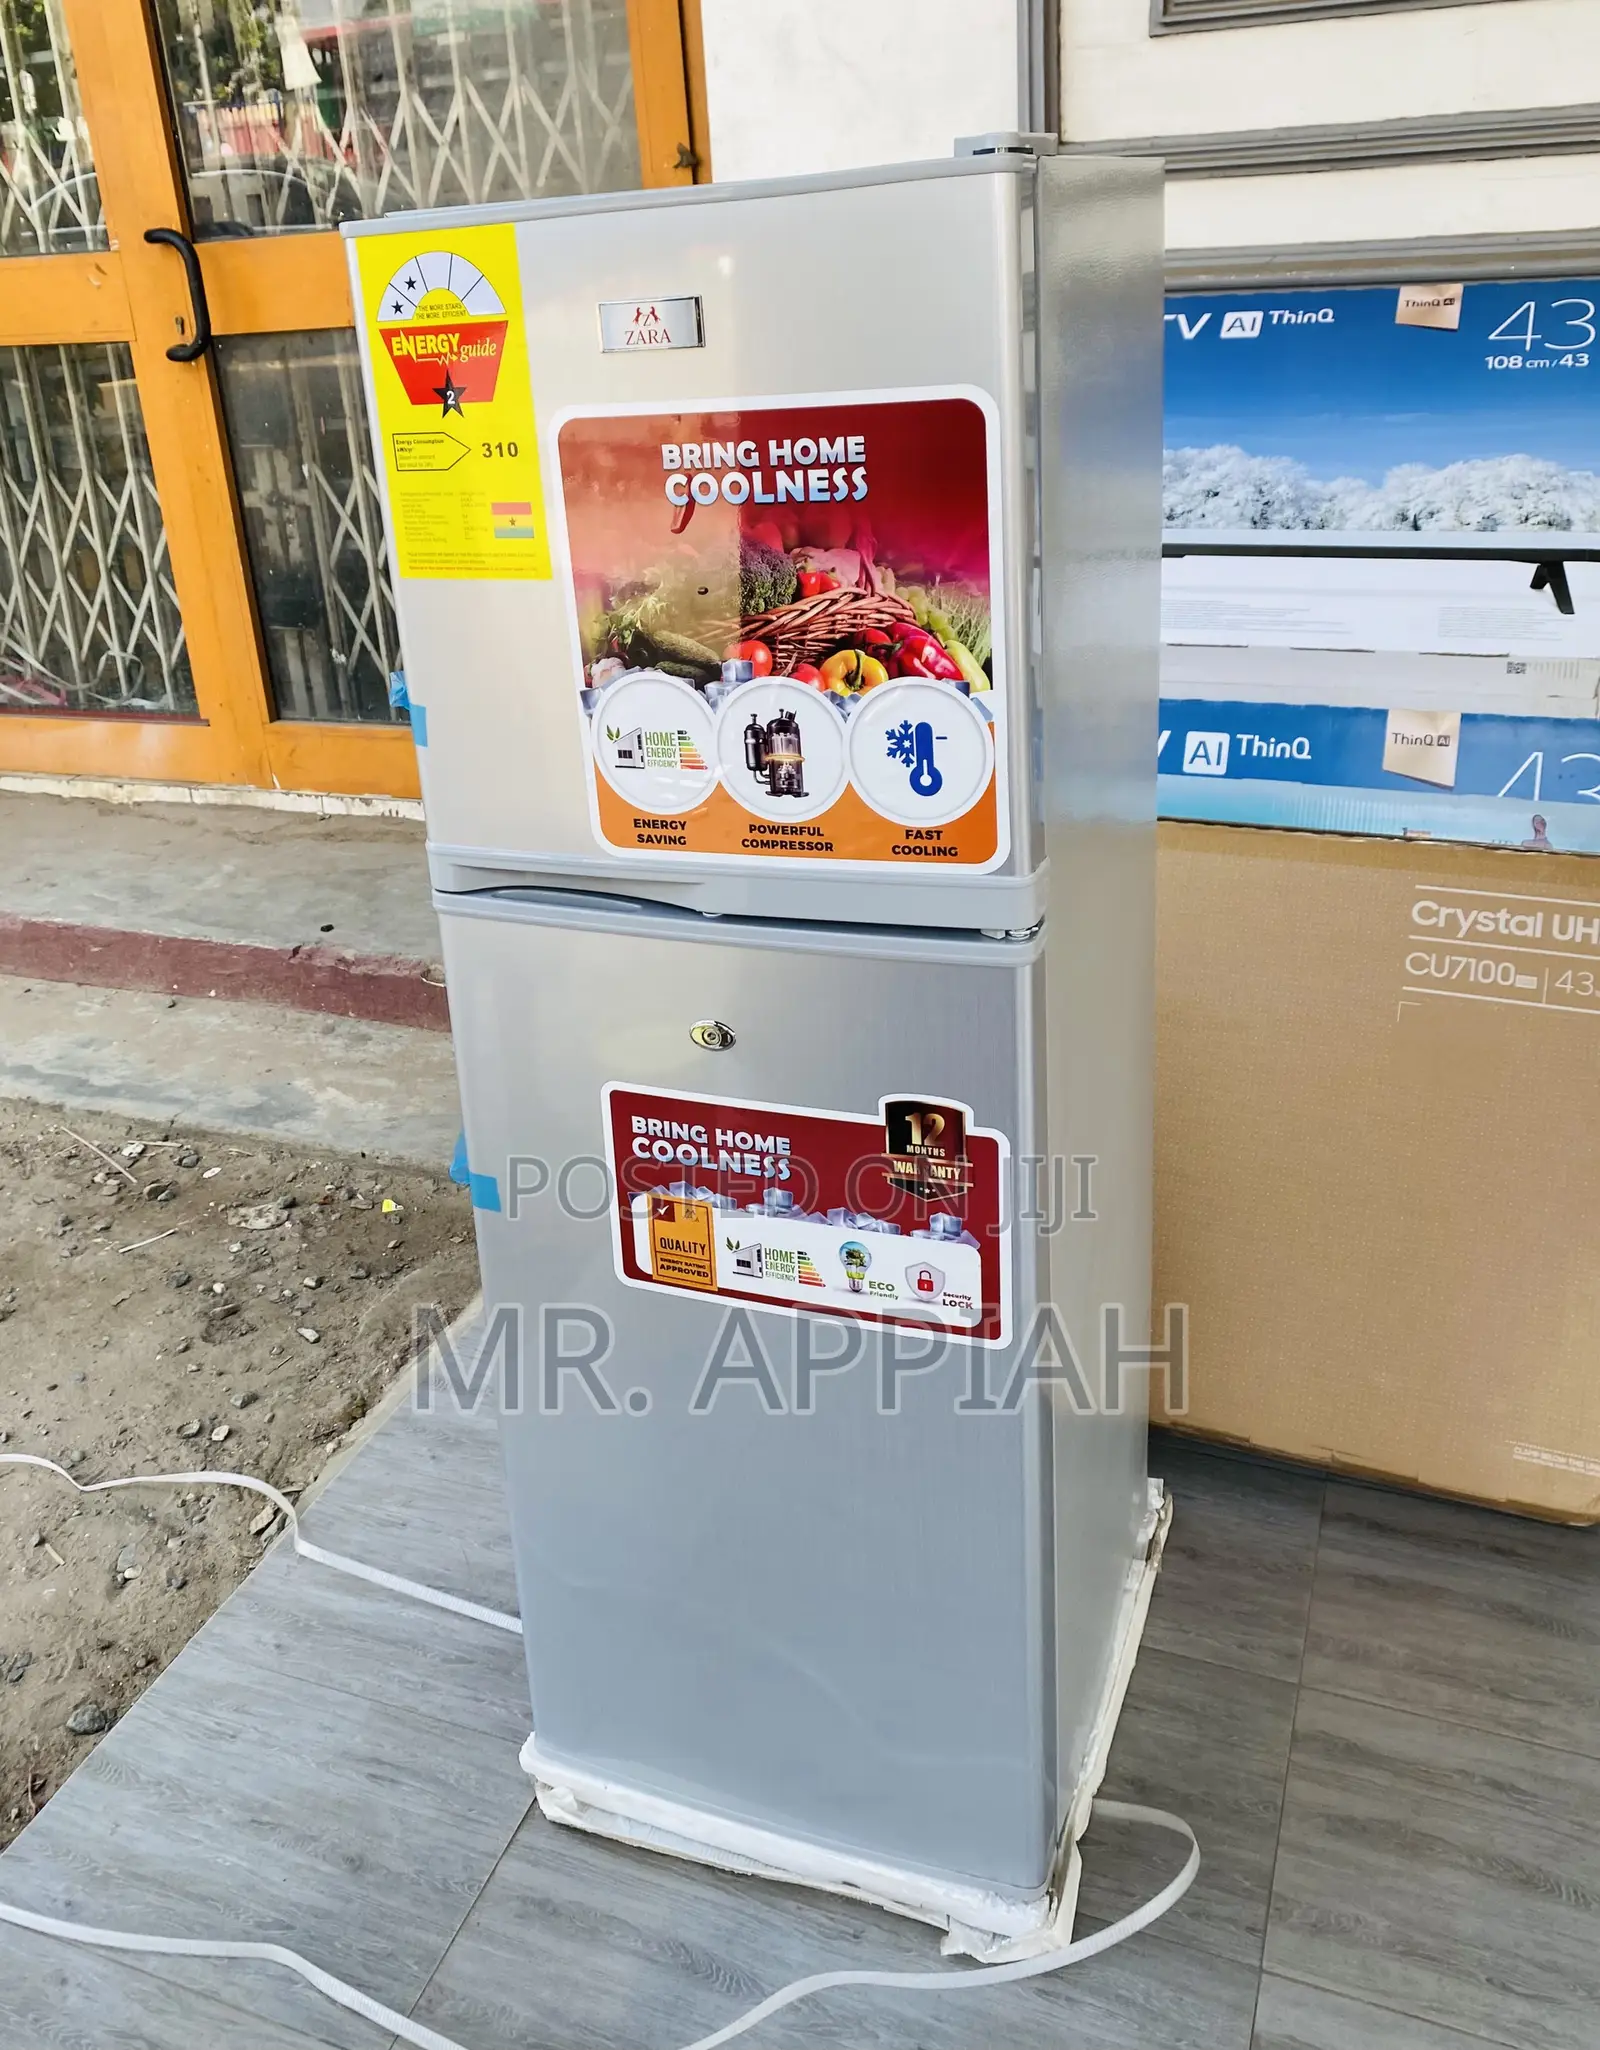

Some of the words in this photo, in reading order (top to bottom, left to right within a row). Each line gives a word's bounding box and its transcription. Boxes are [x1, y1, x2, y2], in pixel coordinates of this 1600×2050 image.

[1404, 298, 1442, 308] ThinQ
[442, 310, 466, 318] EFFICIENT
[1269, 308, 1335, 325] ThinQ
[1488, 298, 1596, 352] 43
[624, 328, 672, 346] ZARA
[391, 331, 460, 362] ENERGY
[460, 338, 496, 363] guide
[1484, 355, 1523, 370] 108
[446, 390, 456, 404] 2
[482, 442, 518, 458] 310
[661, 440, 760, 470] BRING
[768, 435, 867, 466] HOME
[664, 466, 869, 506] COOLNESS
[644, 730, 677, 747] HOME
[1392, 732, 1434, 746] ThinQ
[1438, 736, 1450, 746] AI
[646, 746, 677, 759] ENERGY
[1236, 733, 1312, 760] ThinQ
[647, 759, 678, 769] EFFICIENCY
[633, 818, 687, 831] ENERGY
[748, 824, 824, 838] POWERFUL
[636, 832, 687, 846] SAVING
[904, 829, 943, 842] FAST
[741, 838, 834, 853] COMPRESSOR
[891, 842, 959, 858] COOLING
[1412, 900, 1544, 938] Crystal
[1552, 913, 1600, 945] UH
[1405, 952, 1516, 986] CU7100
[1554, 970, 1595, 996] 43
[631, 1114, 708, 1145] BRING
[715, 1128, 791, 1156] HOME
[905, 1112, 946, 1146] 12
[906, 1145, 946, 1157] MONTHS
[632, 1136, 791, 1181] COOLNESS
[660, 1237, 706, 1256] QUALITY
[764, 1248, 795, 1264] HOME
[660, 1264, 709, 1278] APPROVED
[684, 1261, 706, 1269] RATING
[765, 1260, 796, 1274] ENERGY
[765, 1271, 796, 1282] EFFICIENCY
[868, 1280, 895, 1292] ECO
[869, 1291, 899, 1300] Friendly
[943, 1292, 972, 1301] Security
[942, 1299, 974, 1310] LOCK
